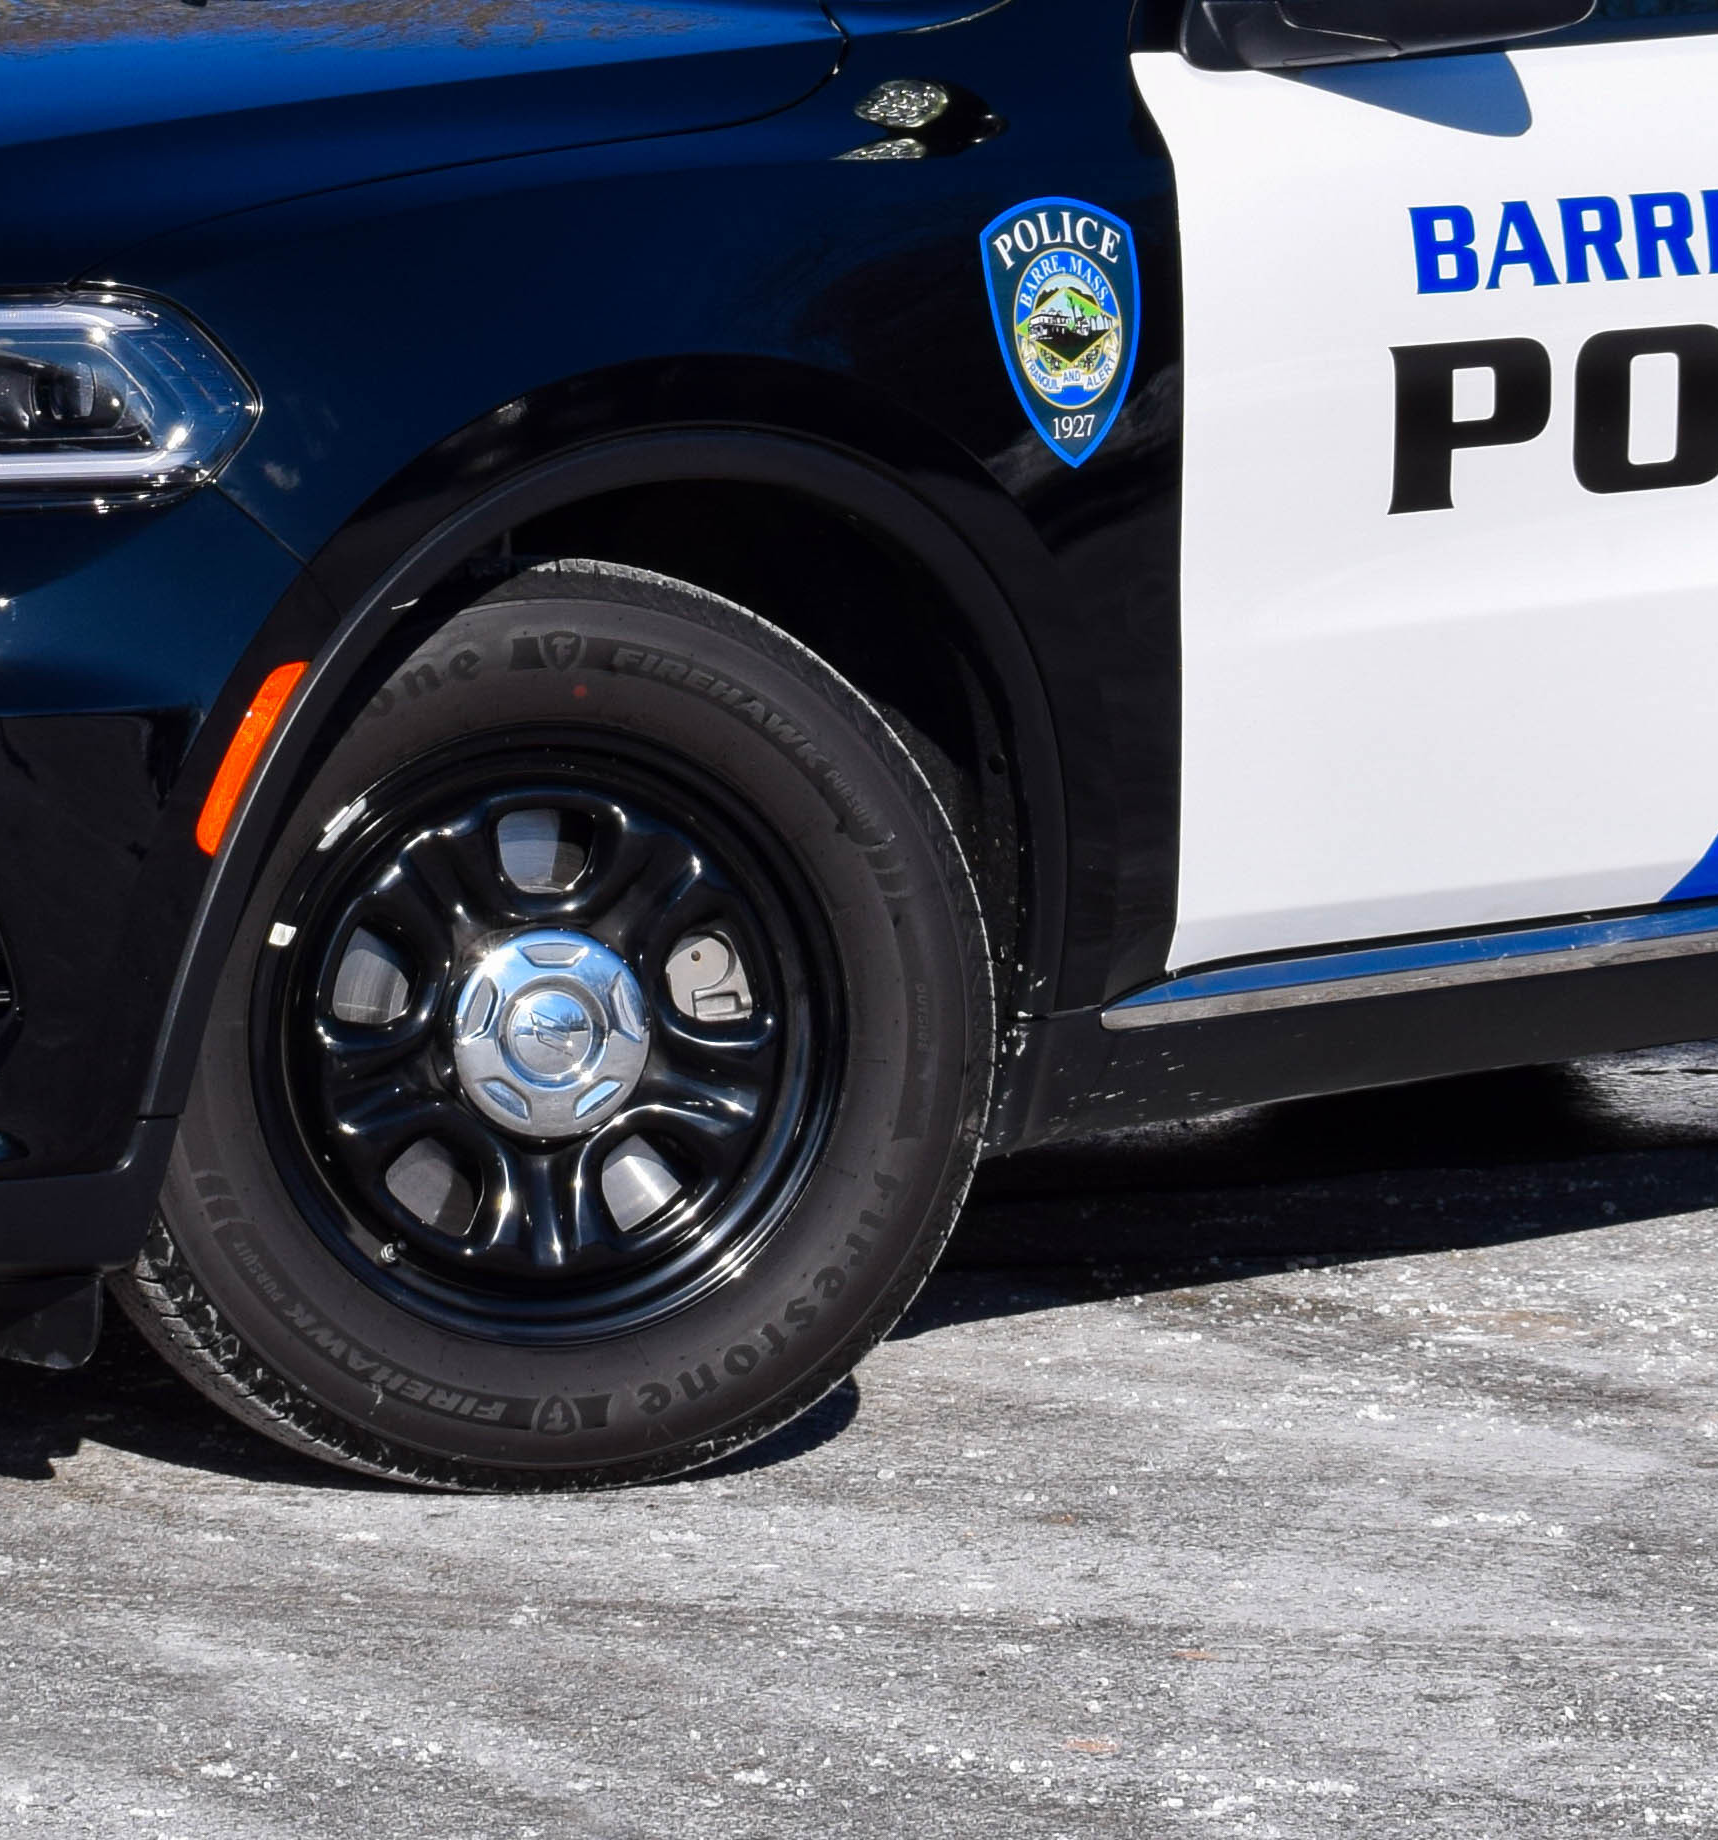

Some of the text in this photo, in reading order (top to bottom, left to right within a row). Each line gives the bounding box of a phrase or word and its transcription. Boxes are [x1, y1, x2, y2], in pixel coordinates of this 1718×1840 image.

[992, 211, 1122, 270] POLICE
[1019, 254, 1109, 309] BARRE, MASS.
[1025, 357, 1117, 391] TRANQUIL AND ALERT
[1052, 413, 1096, 440] 1927
[613, 645, 830, 771] FIREHAWK
[231, 1240, 509, 1424] FIREHAWK PURSUIT
